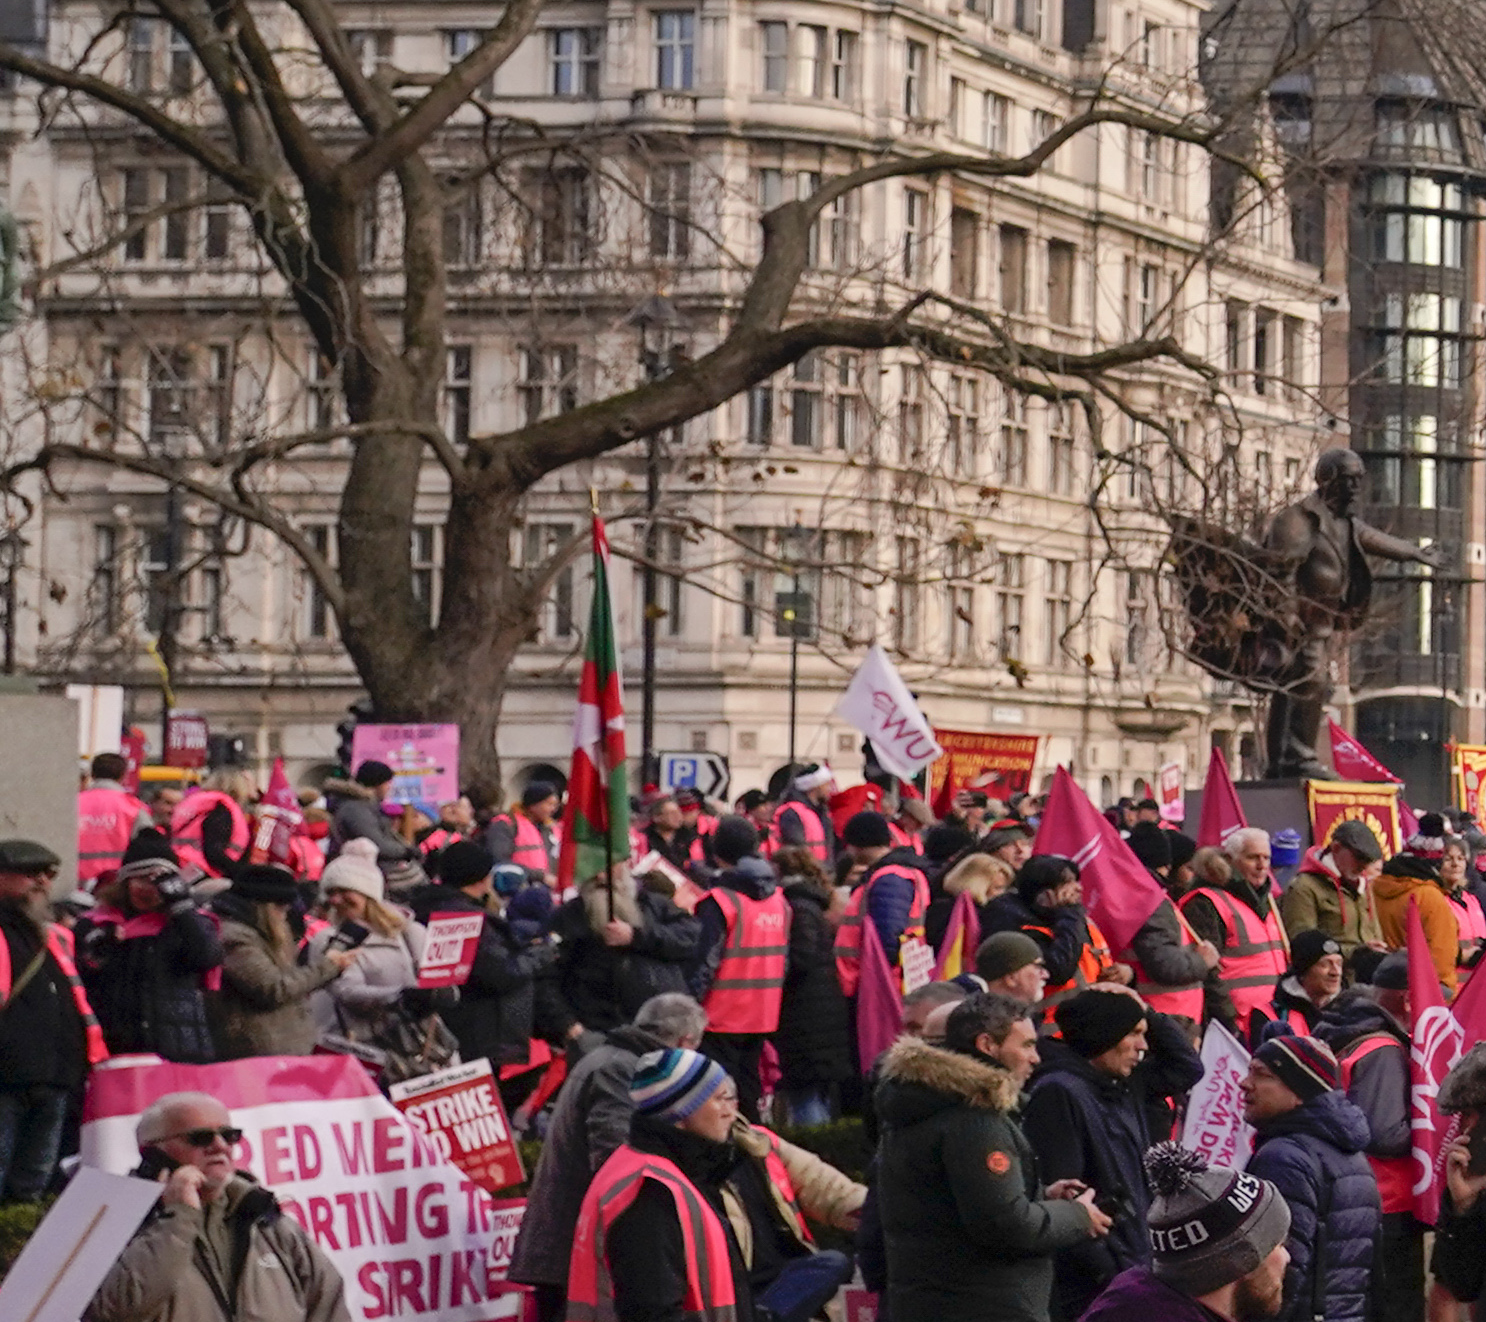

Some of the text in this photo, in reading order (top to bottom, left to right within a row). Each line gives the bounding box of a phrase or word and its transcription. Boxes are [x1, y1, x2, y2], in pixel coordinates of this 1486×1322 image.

[867, 685, 936, 760] CWU
[675, 759, 692, 785] P
[405, 1084, 497, 1131] STRIKE
[453, 1115, 507, 1153] WIN
[1227, 1174, 1260, 1214] WES
